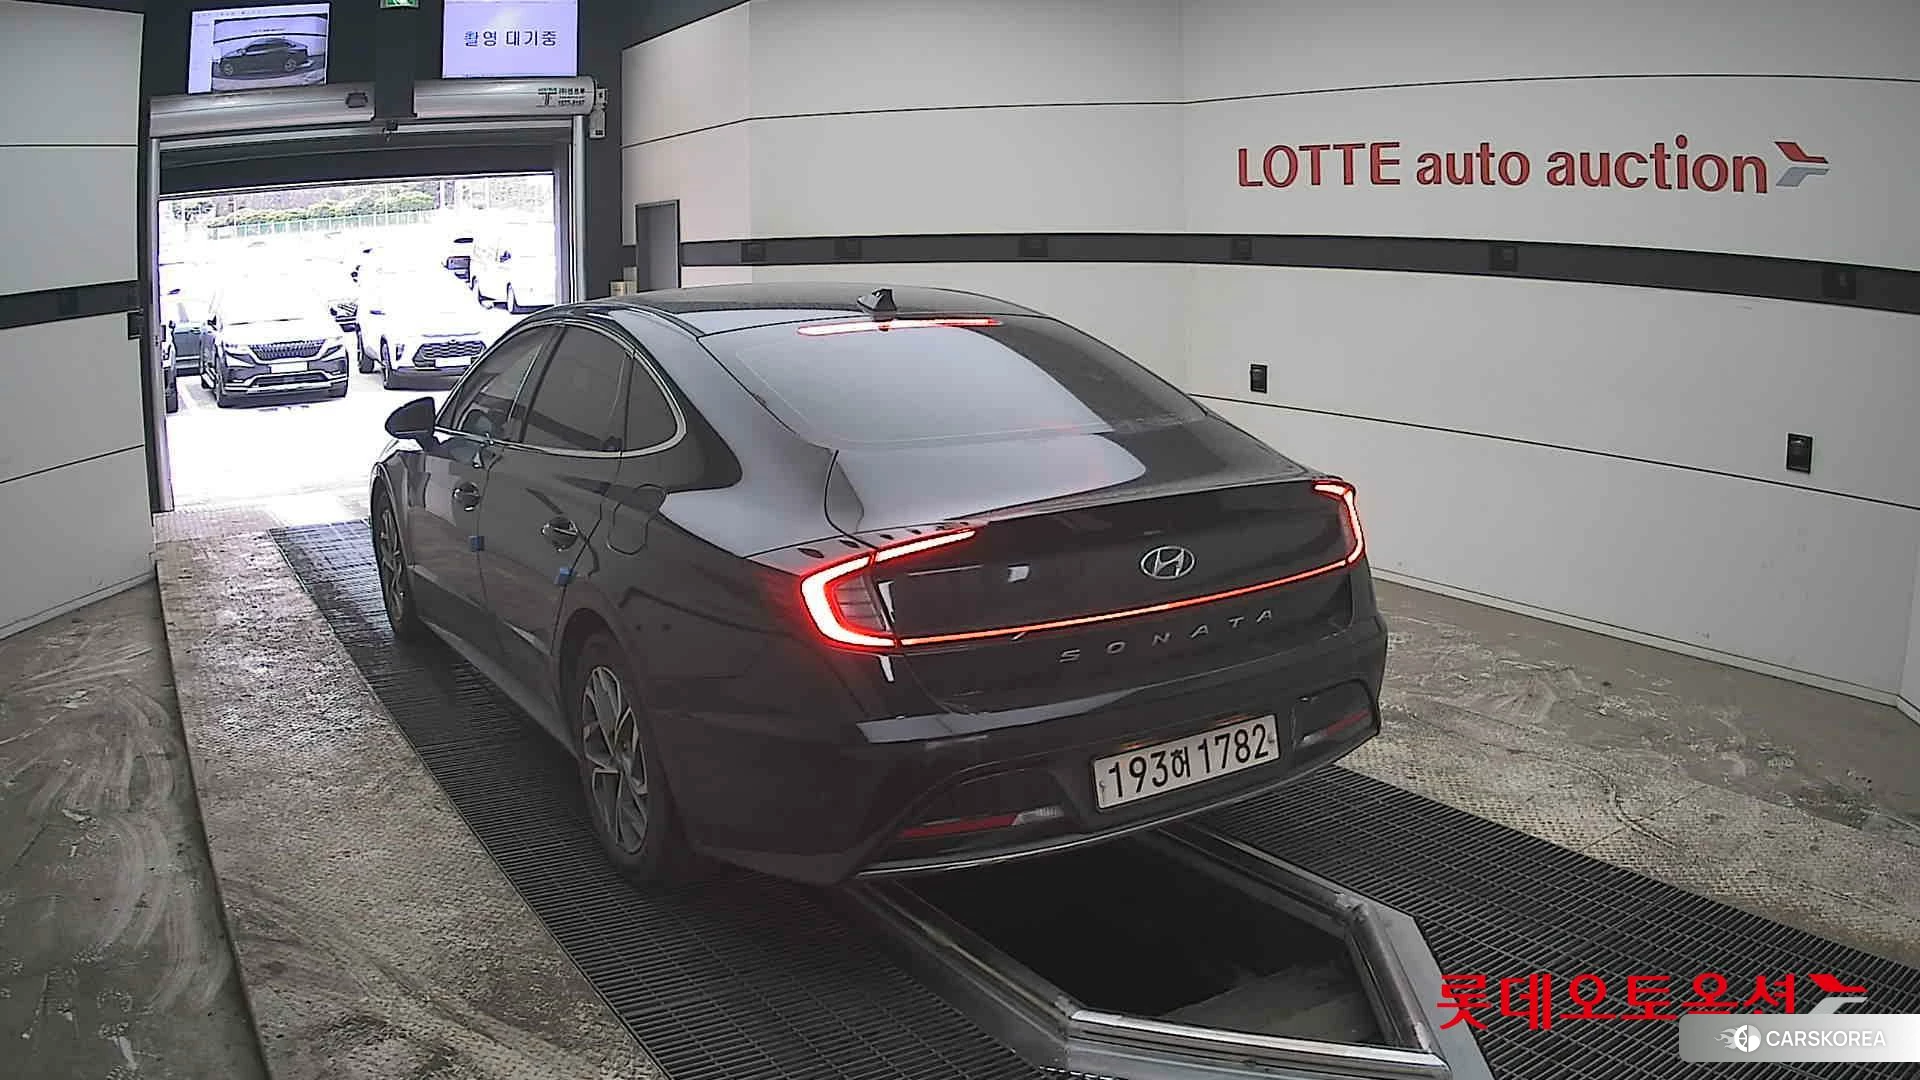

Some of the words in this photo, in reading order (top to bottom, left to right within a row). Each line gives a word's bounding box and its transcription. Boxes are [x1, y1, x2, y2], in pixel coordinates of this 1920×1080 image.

[505, 30, 557, 47] 대기중
[1238, 142, 1400, 188] LOTTE
[1416, 142, 1531, 186] auto
[1546, 134, 1768, 194] auction
[1058, 609, 1273, 663] SONATA
